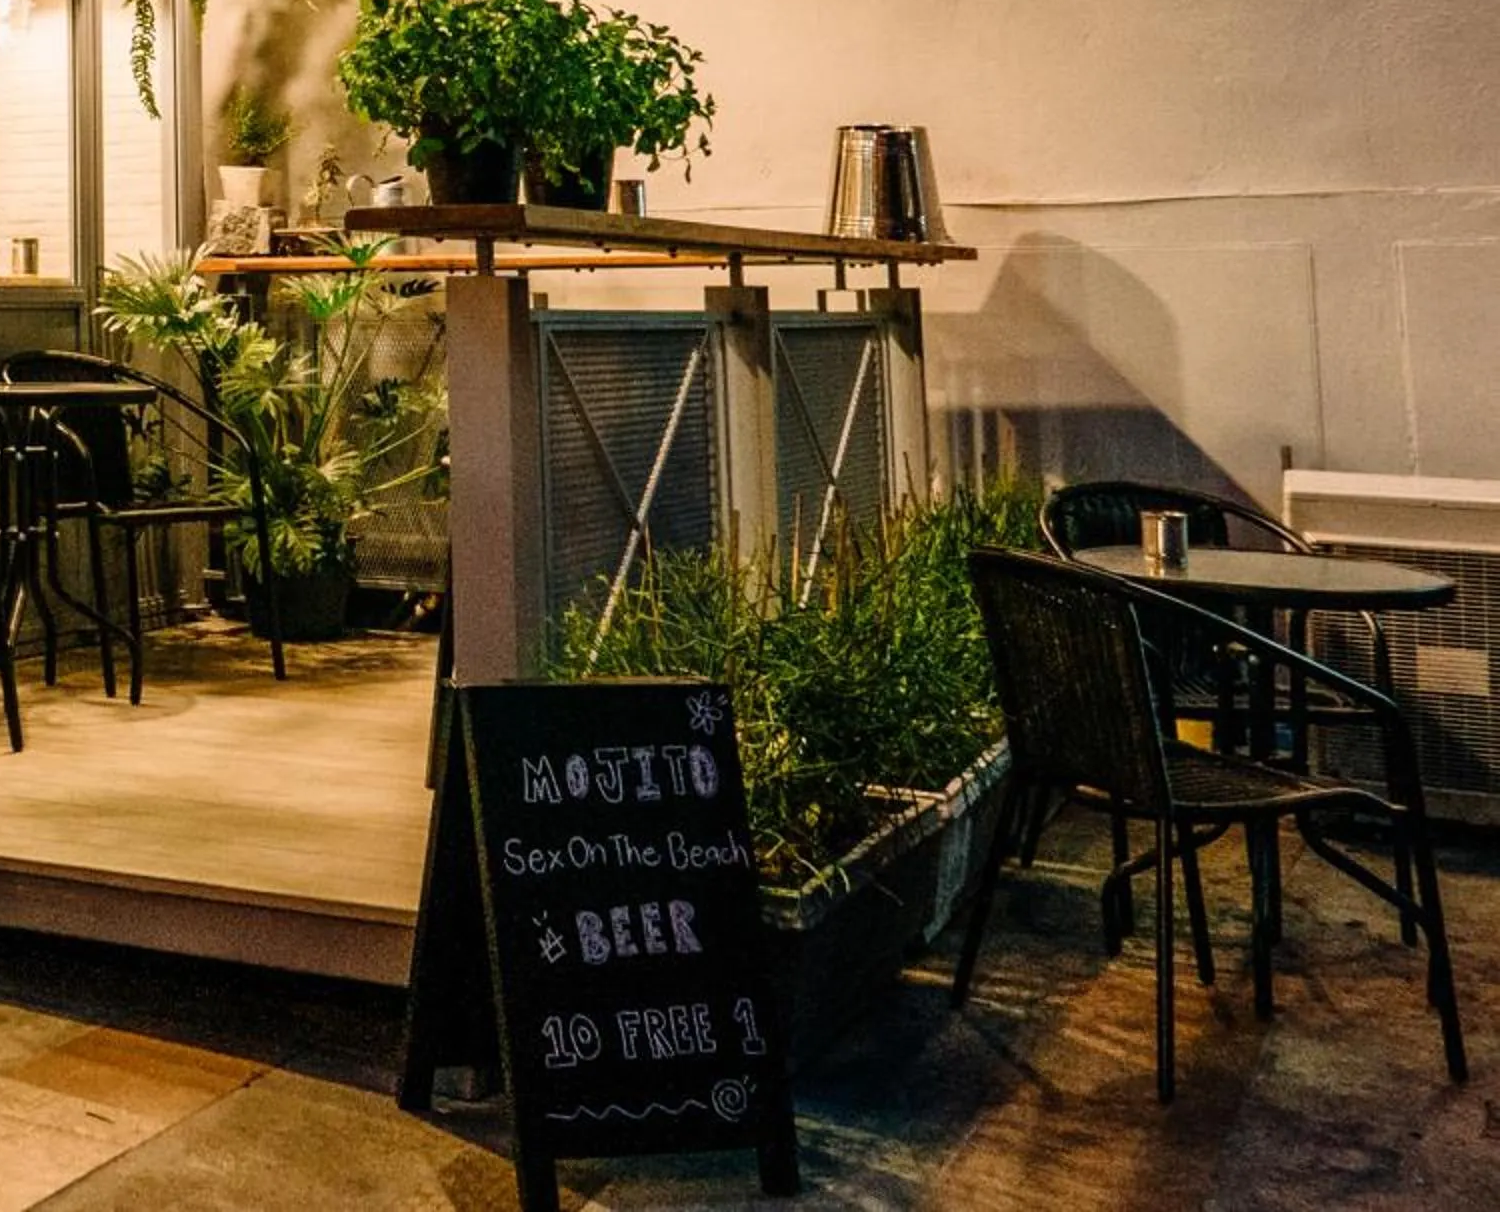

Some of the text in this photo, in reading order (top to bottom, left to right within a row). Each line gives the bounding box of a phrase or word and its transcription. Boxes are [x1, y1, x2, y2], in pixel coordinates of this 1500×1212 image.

[522, 745, 718, 804] MOJITO
[504, 831, 749, 875] Sex On The Beach
[575, 900, 702, 965] BEER
[541, 997, 766, 1068] 10 FREE 1
